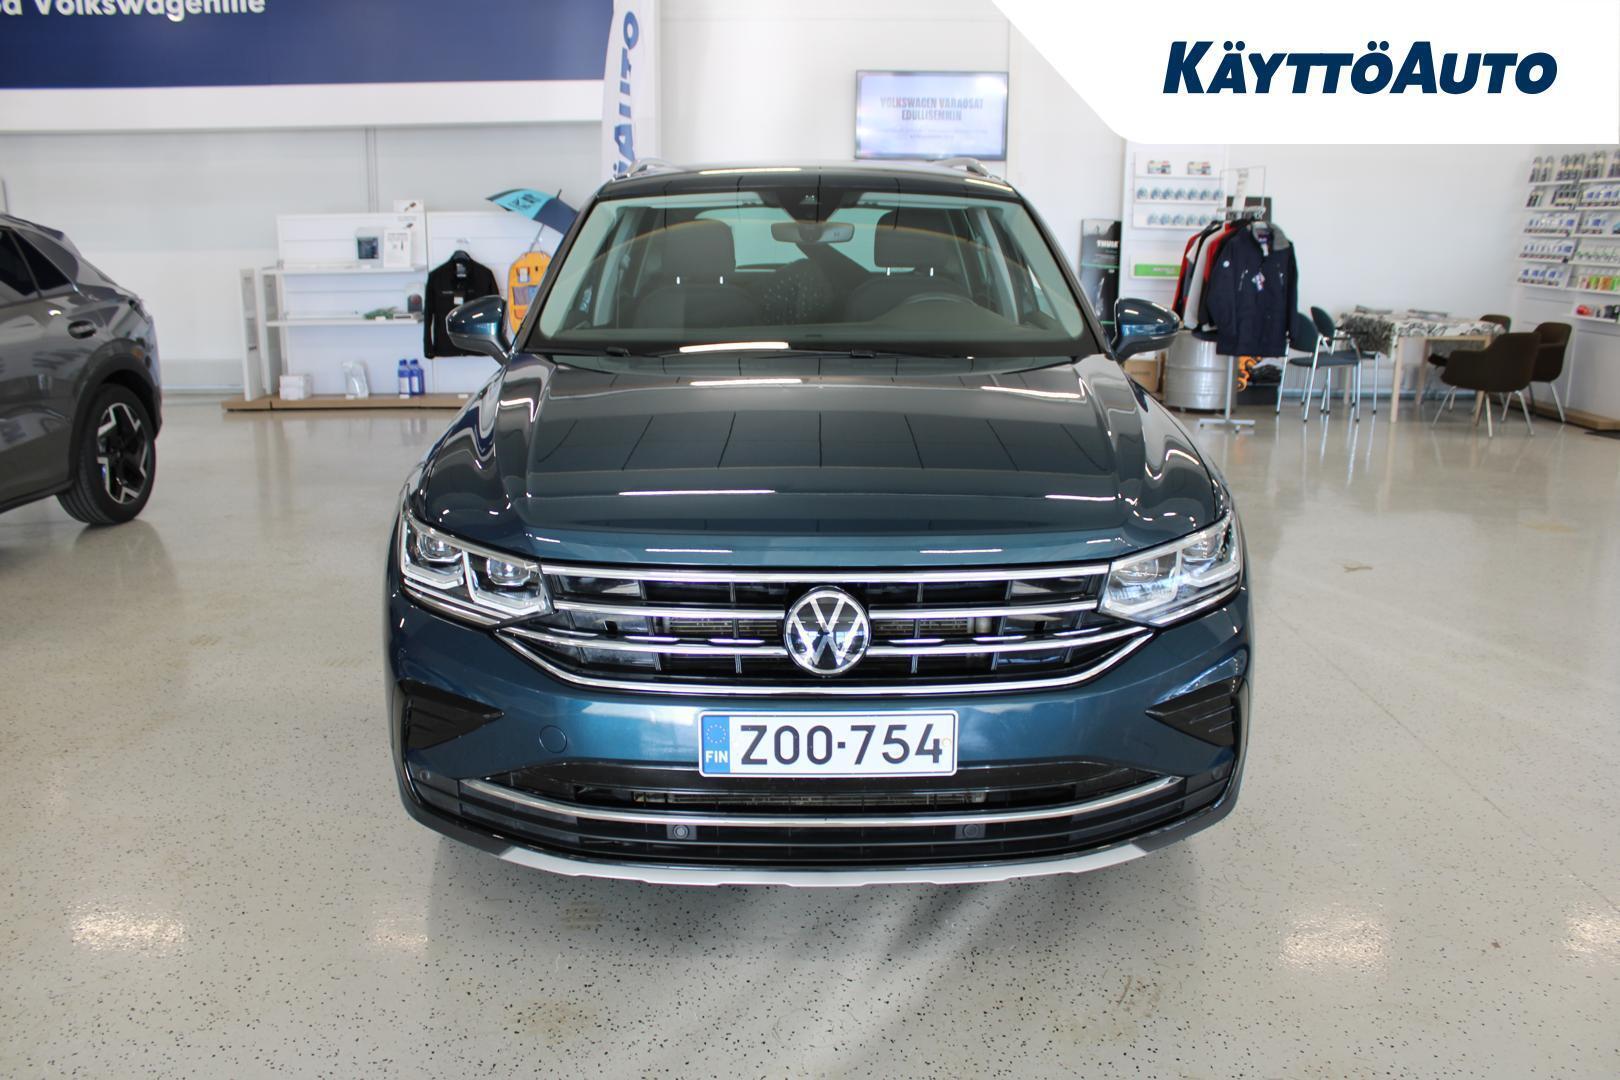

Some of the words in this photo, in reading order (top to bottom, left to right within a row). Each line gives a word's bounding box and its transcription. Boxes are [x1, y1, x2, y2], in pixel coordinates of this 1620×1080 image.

[879, 96, 937, 109] VOLKSWAGEN
[705, 750, 729, 764] FIN
[740, 723, 943, 766] ZOO-754
